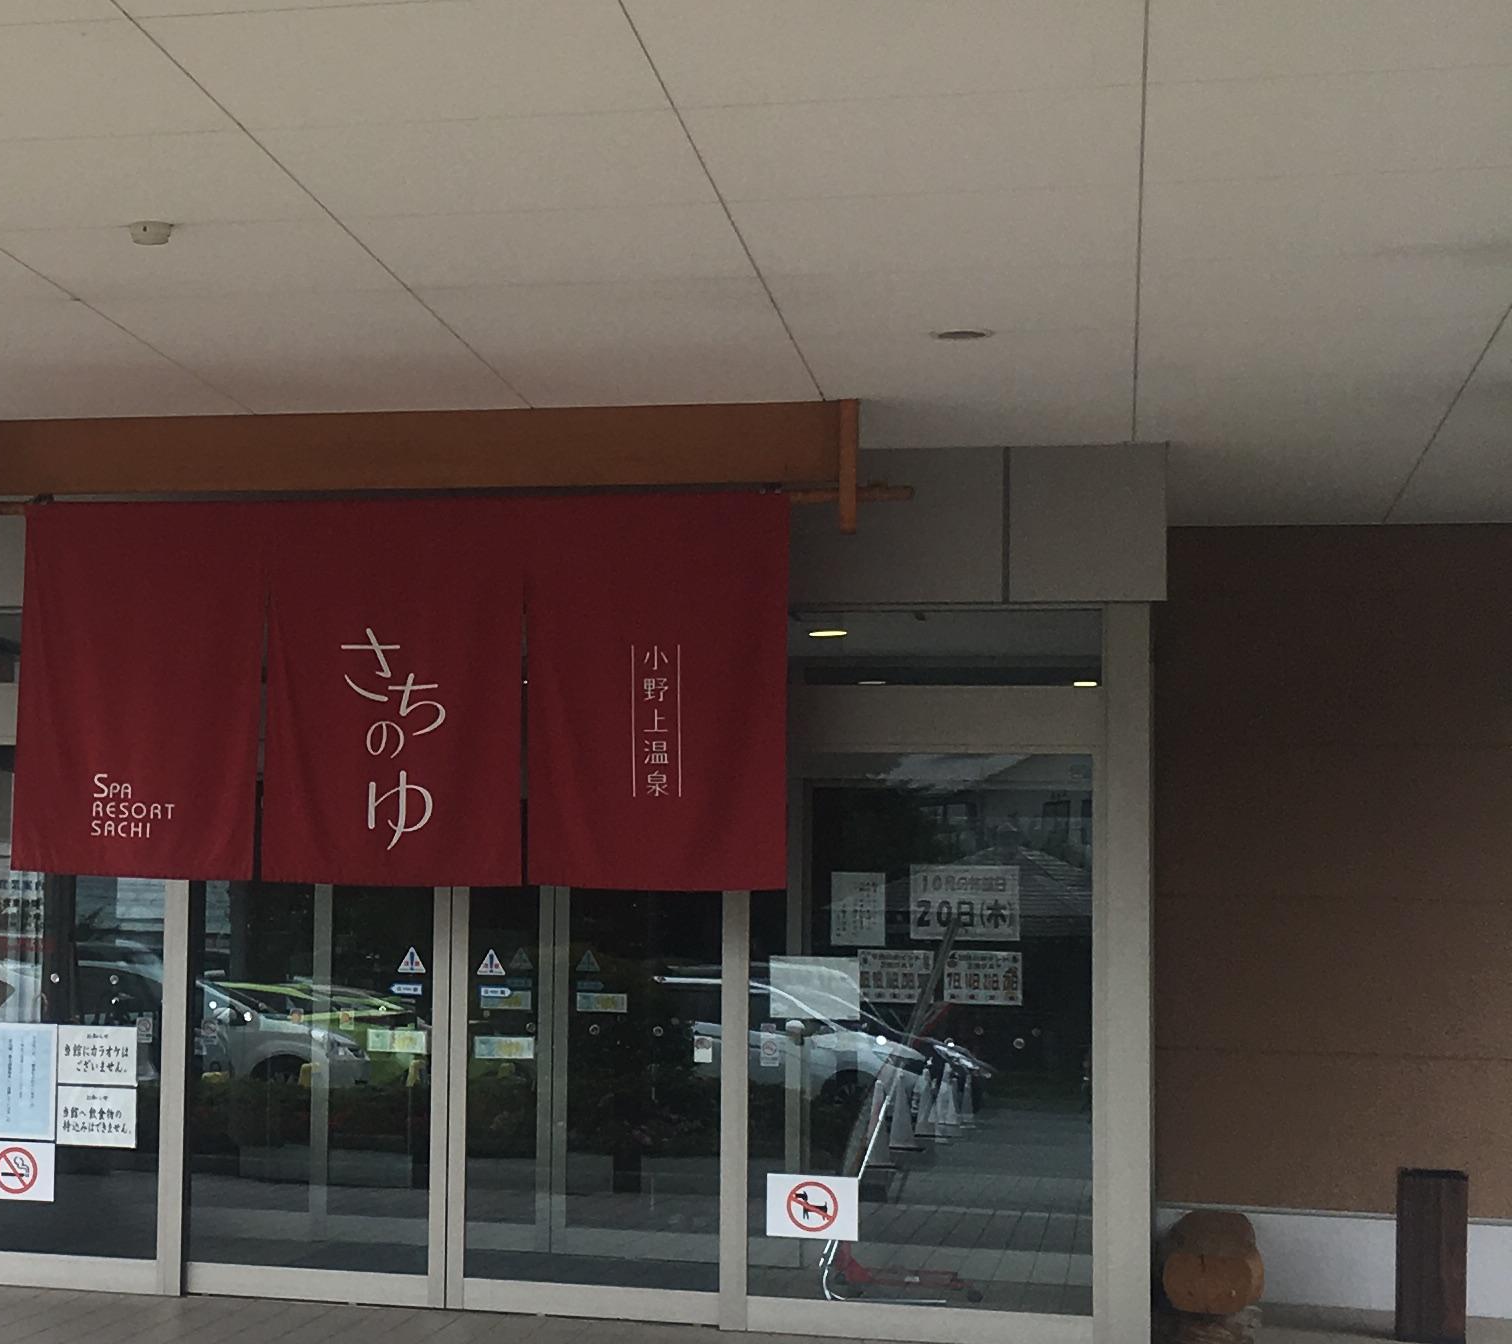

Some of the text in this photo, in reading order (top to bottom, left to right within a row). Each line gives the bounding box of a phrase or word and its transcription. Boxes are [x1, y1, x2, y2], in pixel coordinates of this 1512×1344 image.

[643, 645, 669, 797] 小野上温泉
[340, 627, 446, 850] さちのゆ
[92, 801, 175, 819] RESORT
[90, 820, 150, 838] SACHI
[64, 1044, 129, 1057] 当館にカラオケは
[76, 1060, 127, 1073] ございません。
